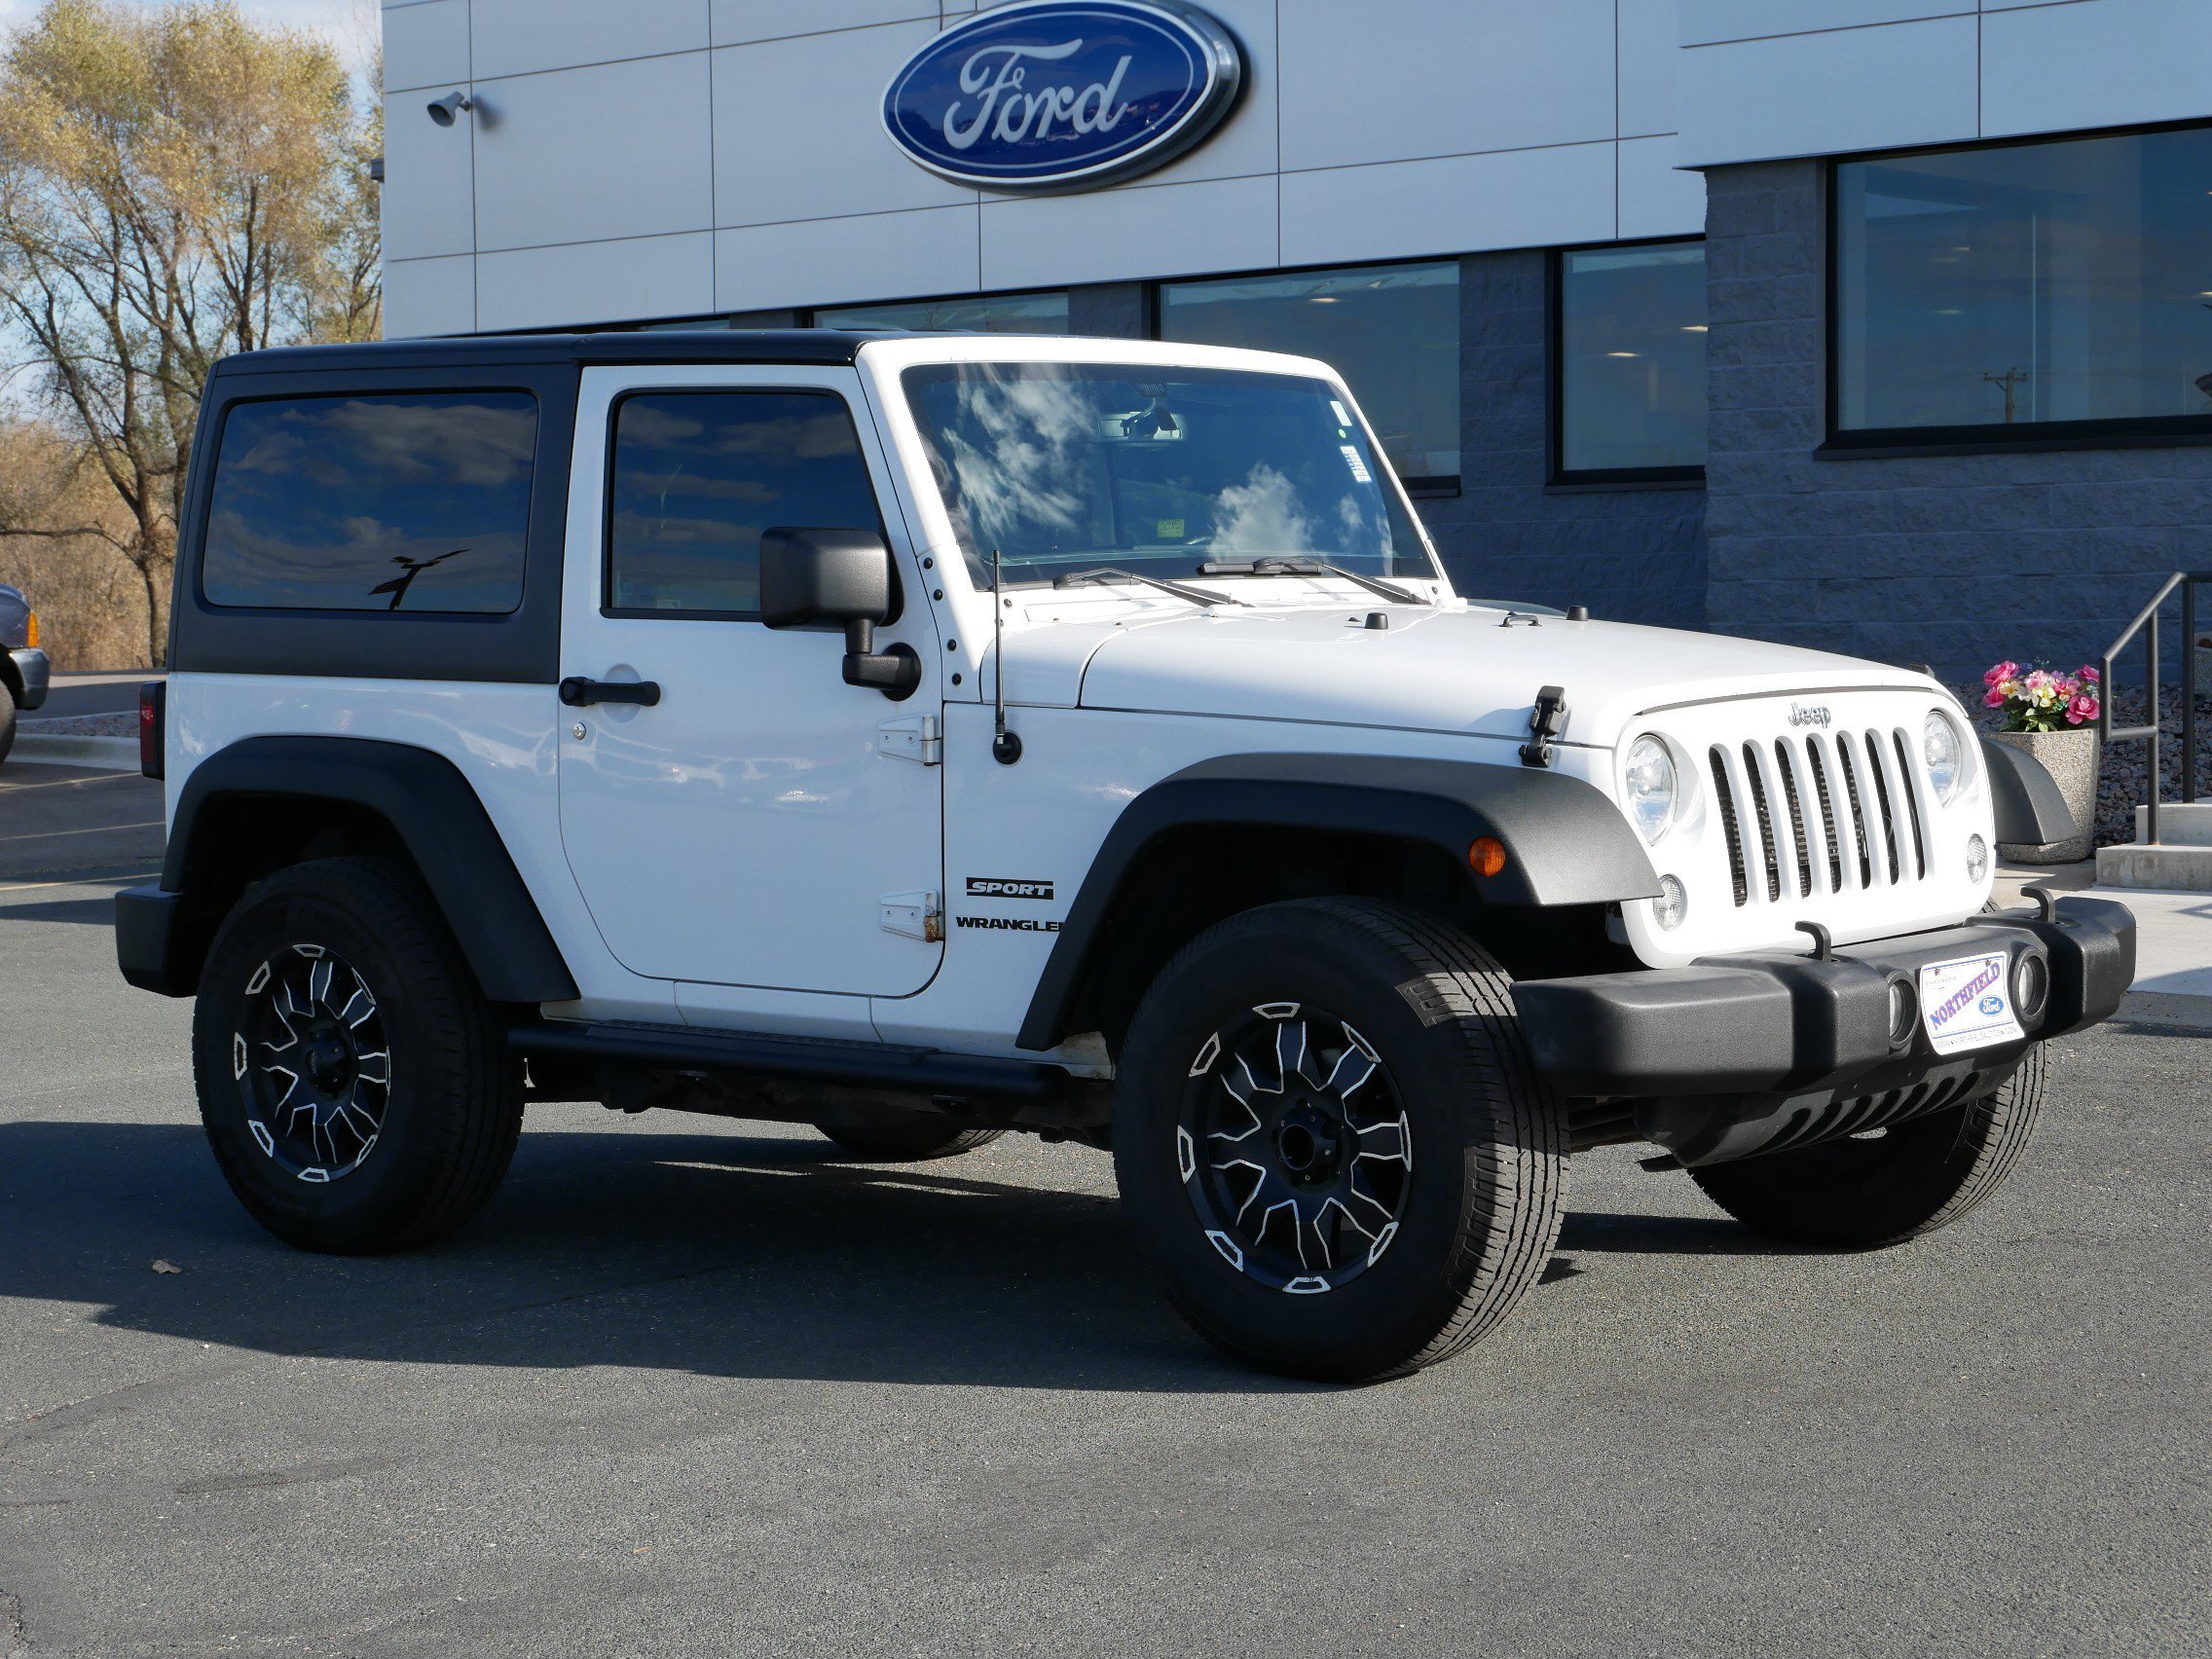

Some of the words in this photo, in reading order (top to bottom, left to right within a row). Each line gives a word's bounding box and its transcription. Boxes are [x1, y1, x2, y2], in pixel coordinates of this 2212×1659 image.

[943, 38, 1132, 149] Ford
[1788, 702, 1830, 728] Jeep
[971, 880, 1053, 897] SPORT
[1930, 962, 2001, 1030] NORTHFIELD
[1982, 998, 2001, 1014] Ford
